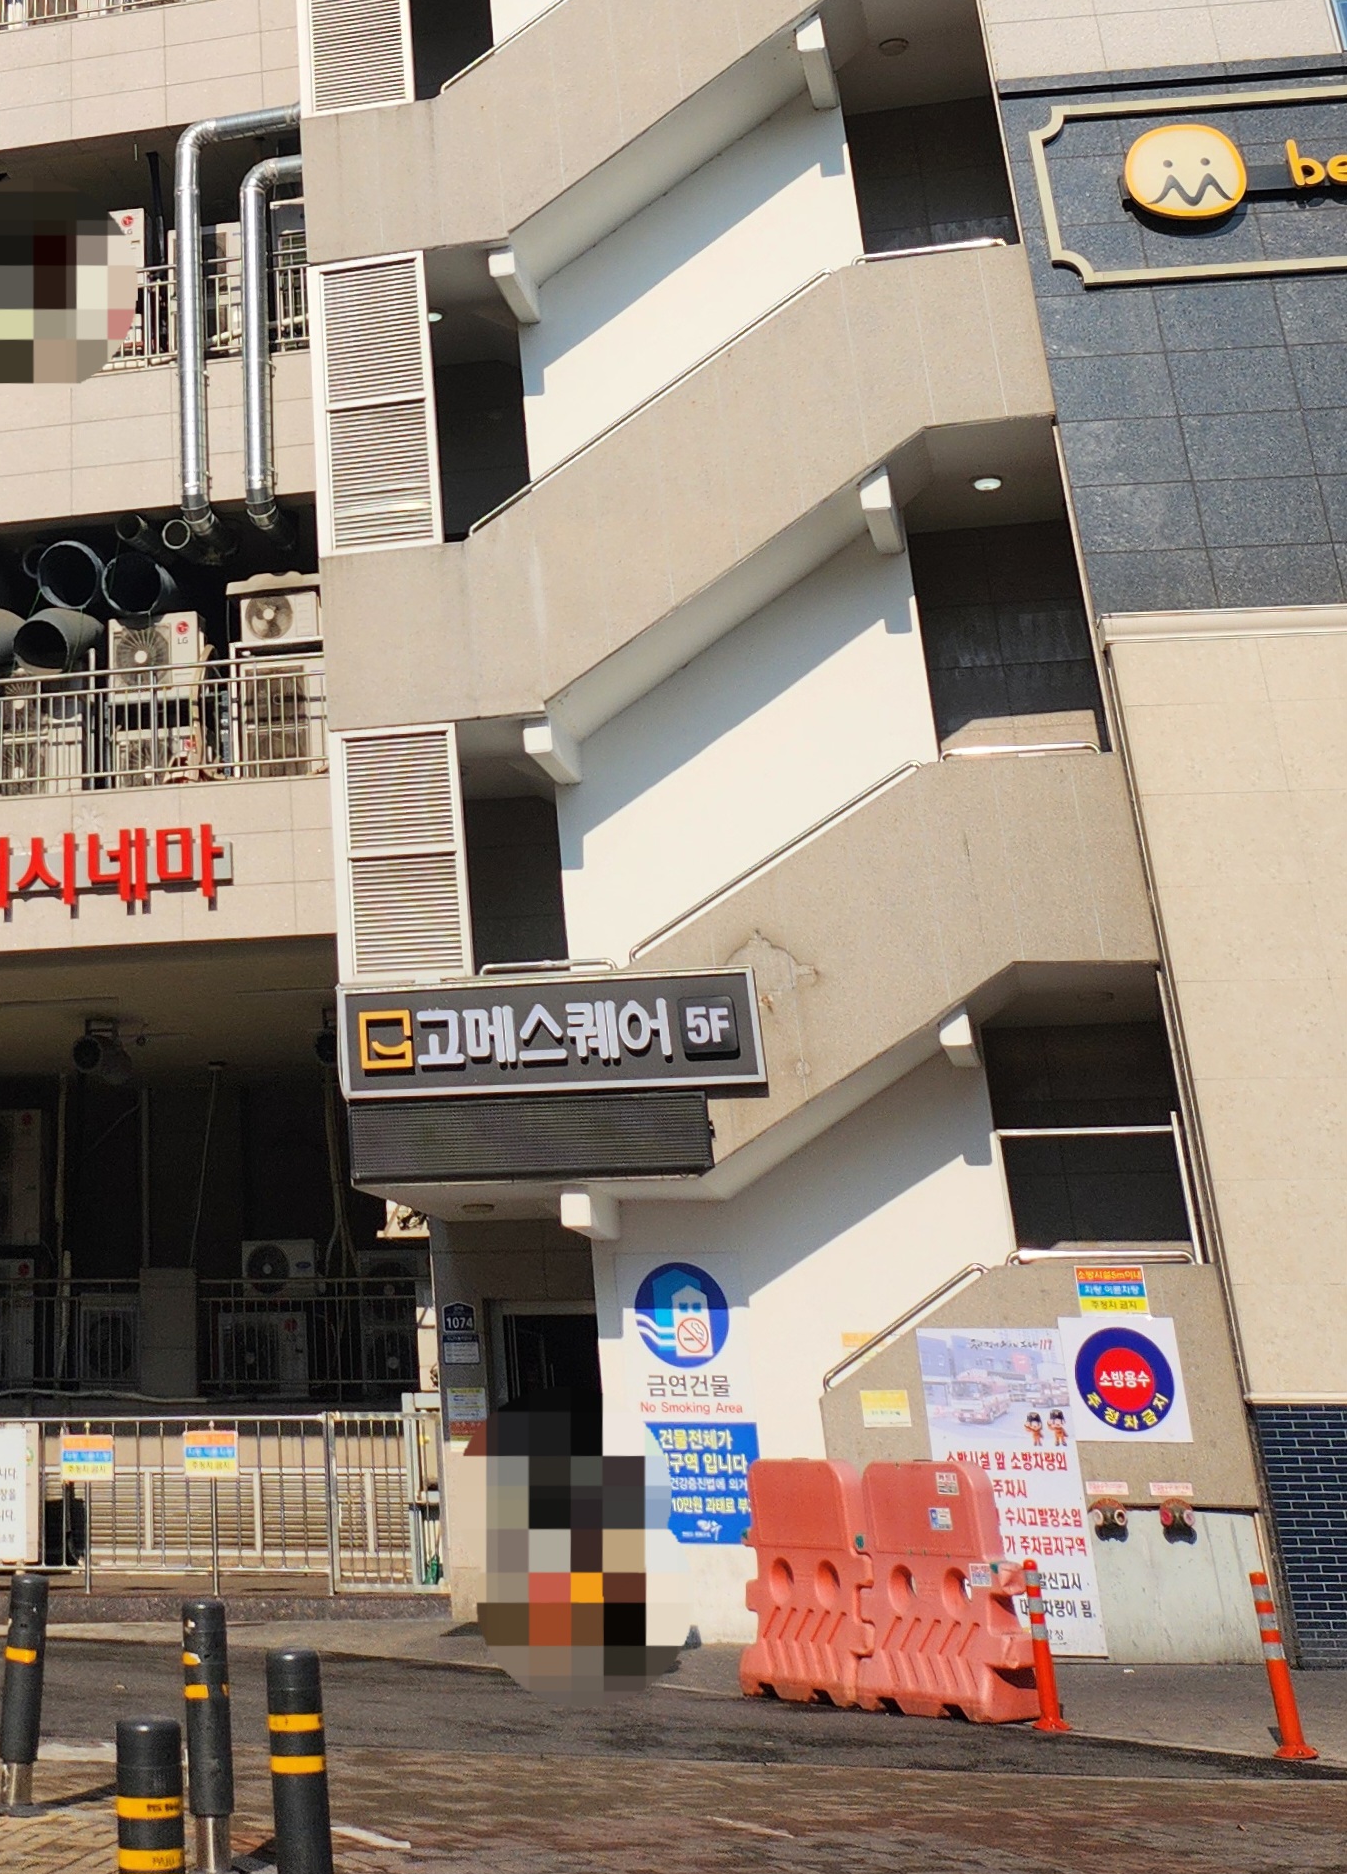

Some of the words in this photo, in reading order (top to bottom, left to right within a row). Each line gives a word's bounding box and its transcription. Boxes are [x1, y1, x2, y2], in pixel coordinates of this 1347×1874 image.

[177, 636, 189, 645] LG
[416, 997, 672, 1067] 고메스퀘어
[686, 1006, 730, 1046] 5F
[446, 1316, 474, 1329] 1074
[647, 1374, 731, 1398] 금연건물
[1099, 1370, 1152, 1389] 소방용수
[640, 1401, 657, 1414] No
[661, 1401, 711, 1415] Smoking
[715, 1401, 743, 1414] Area
[658, 1428, 733, 1451] 건물전체가
[703, 1453, 748, 1475] 입니다
[994, 1451, 1007, 1470] 앞
[1010, 1451, 1068, 1471] 소방차량외
[1020, 1536, 1088, 1556] 주차금지구역
